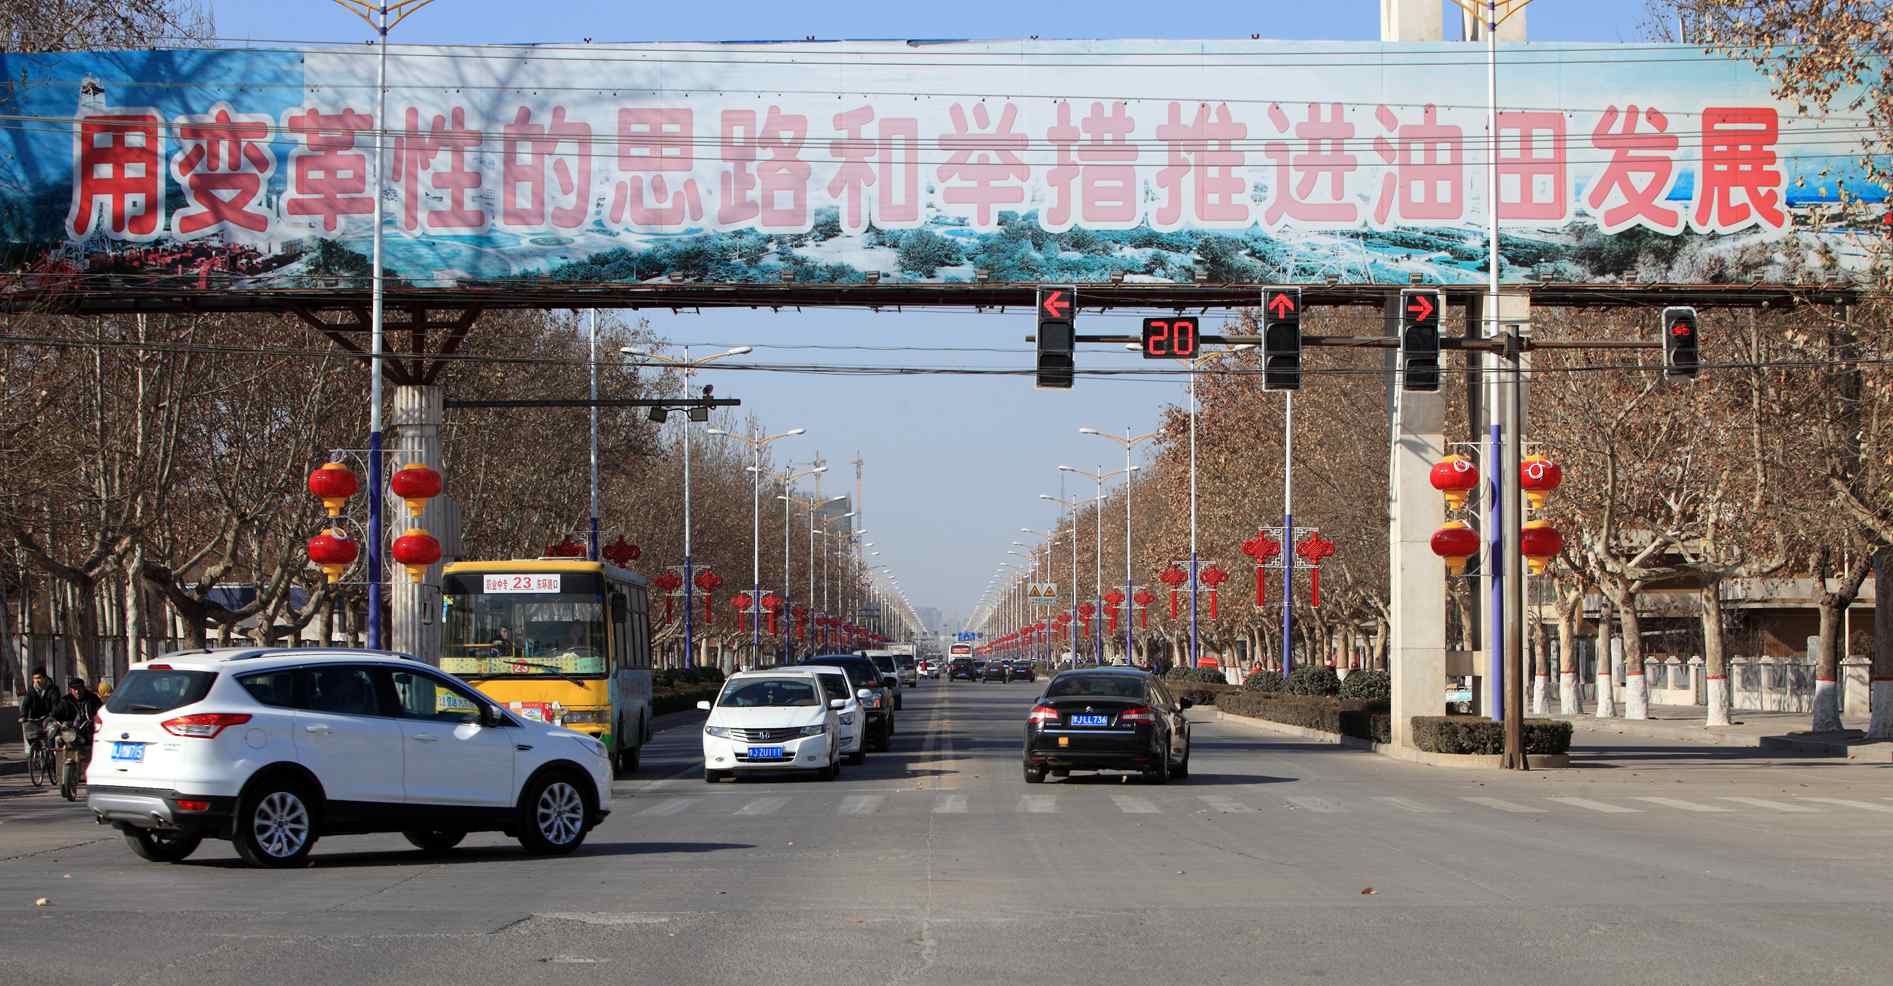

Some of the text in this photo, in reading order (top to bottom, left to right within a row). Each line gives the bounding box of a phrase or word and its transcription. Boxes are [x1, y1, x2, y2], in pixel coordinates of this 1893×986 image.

[72, 101, 1787, 235] 用变革性的思路和举措推进油田发展
[1148, 321, 1192, 354] 20
[513, 577, 531, 589] 23
